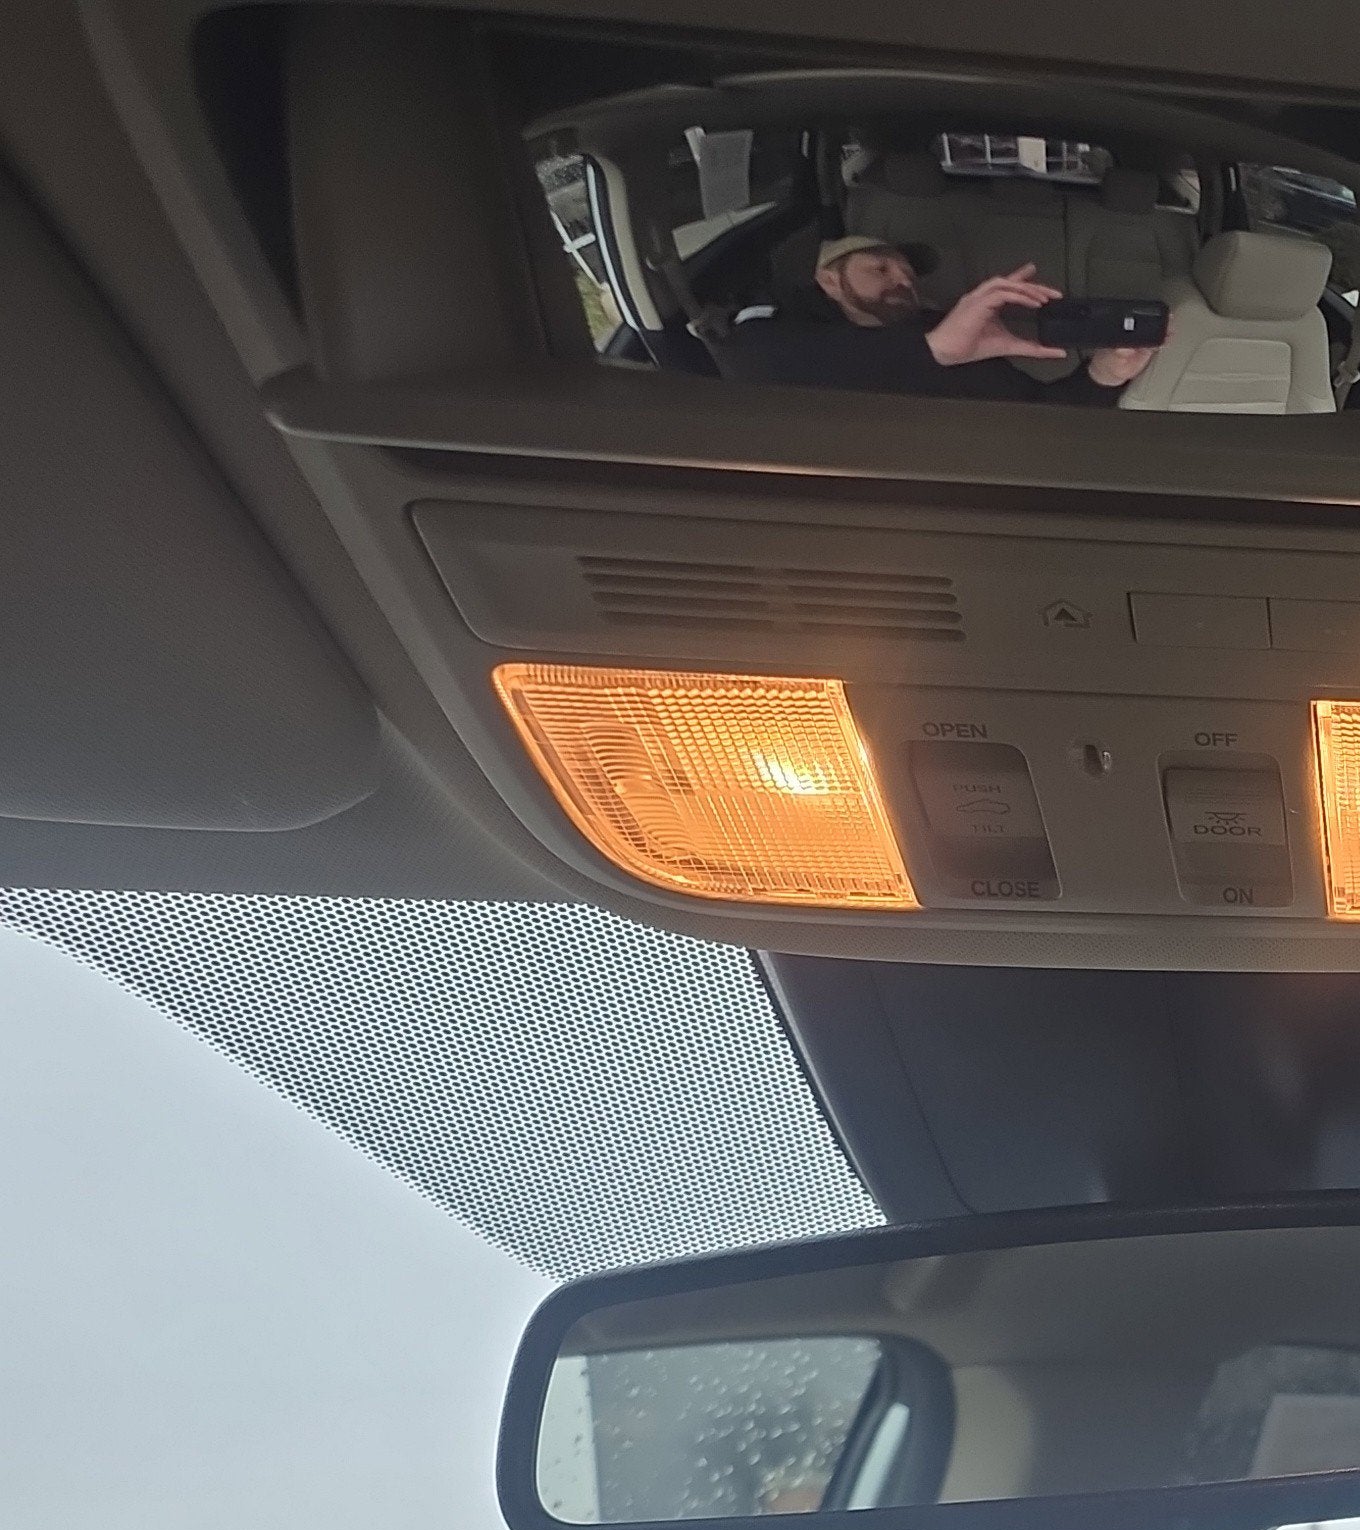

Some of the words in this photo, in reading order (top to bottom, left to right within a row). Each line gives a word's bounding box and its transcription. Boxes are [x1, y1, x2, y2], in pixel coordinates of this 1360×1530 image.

[922, 722, 989, 738] OPEN
[1194, 732, 1239, 747] OFF
[953, 784, 1002, 793] PUSH
[1194, 825, 1262, 836] DOOR
[971, 880, 1040, 898] CLOSE
[1223, 888, 1254, 903] ON
